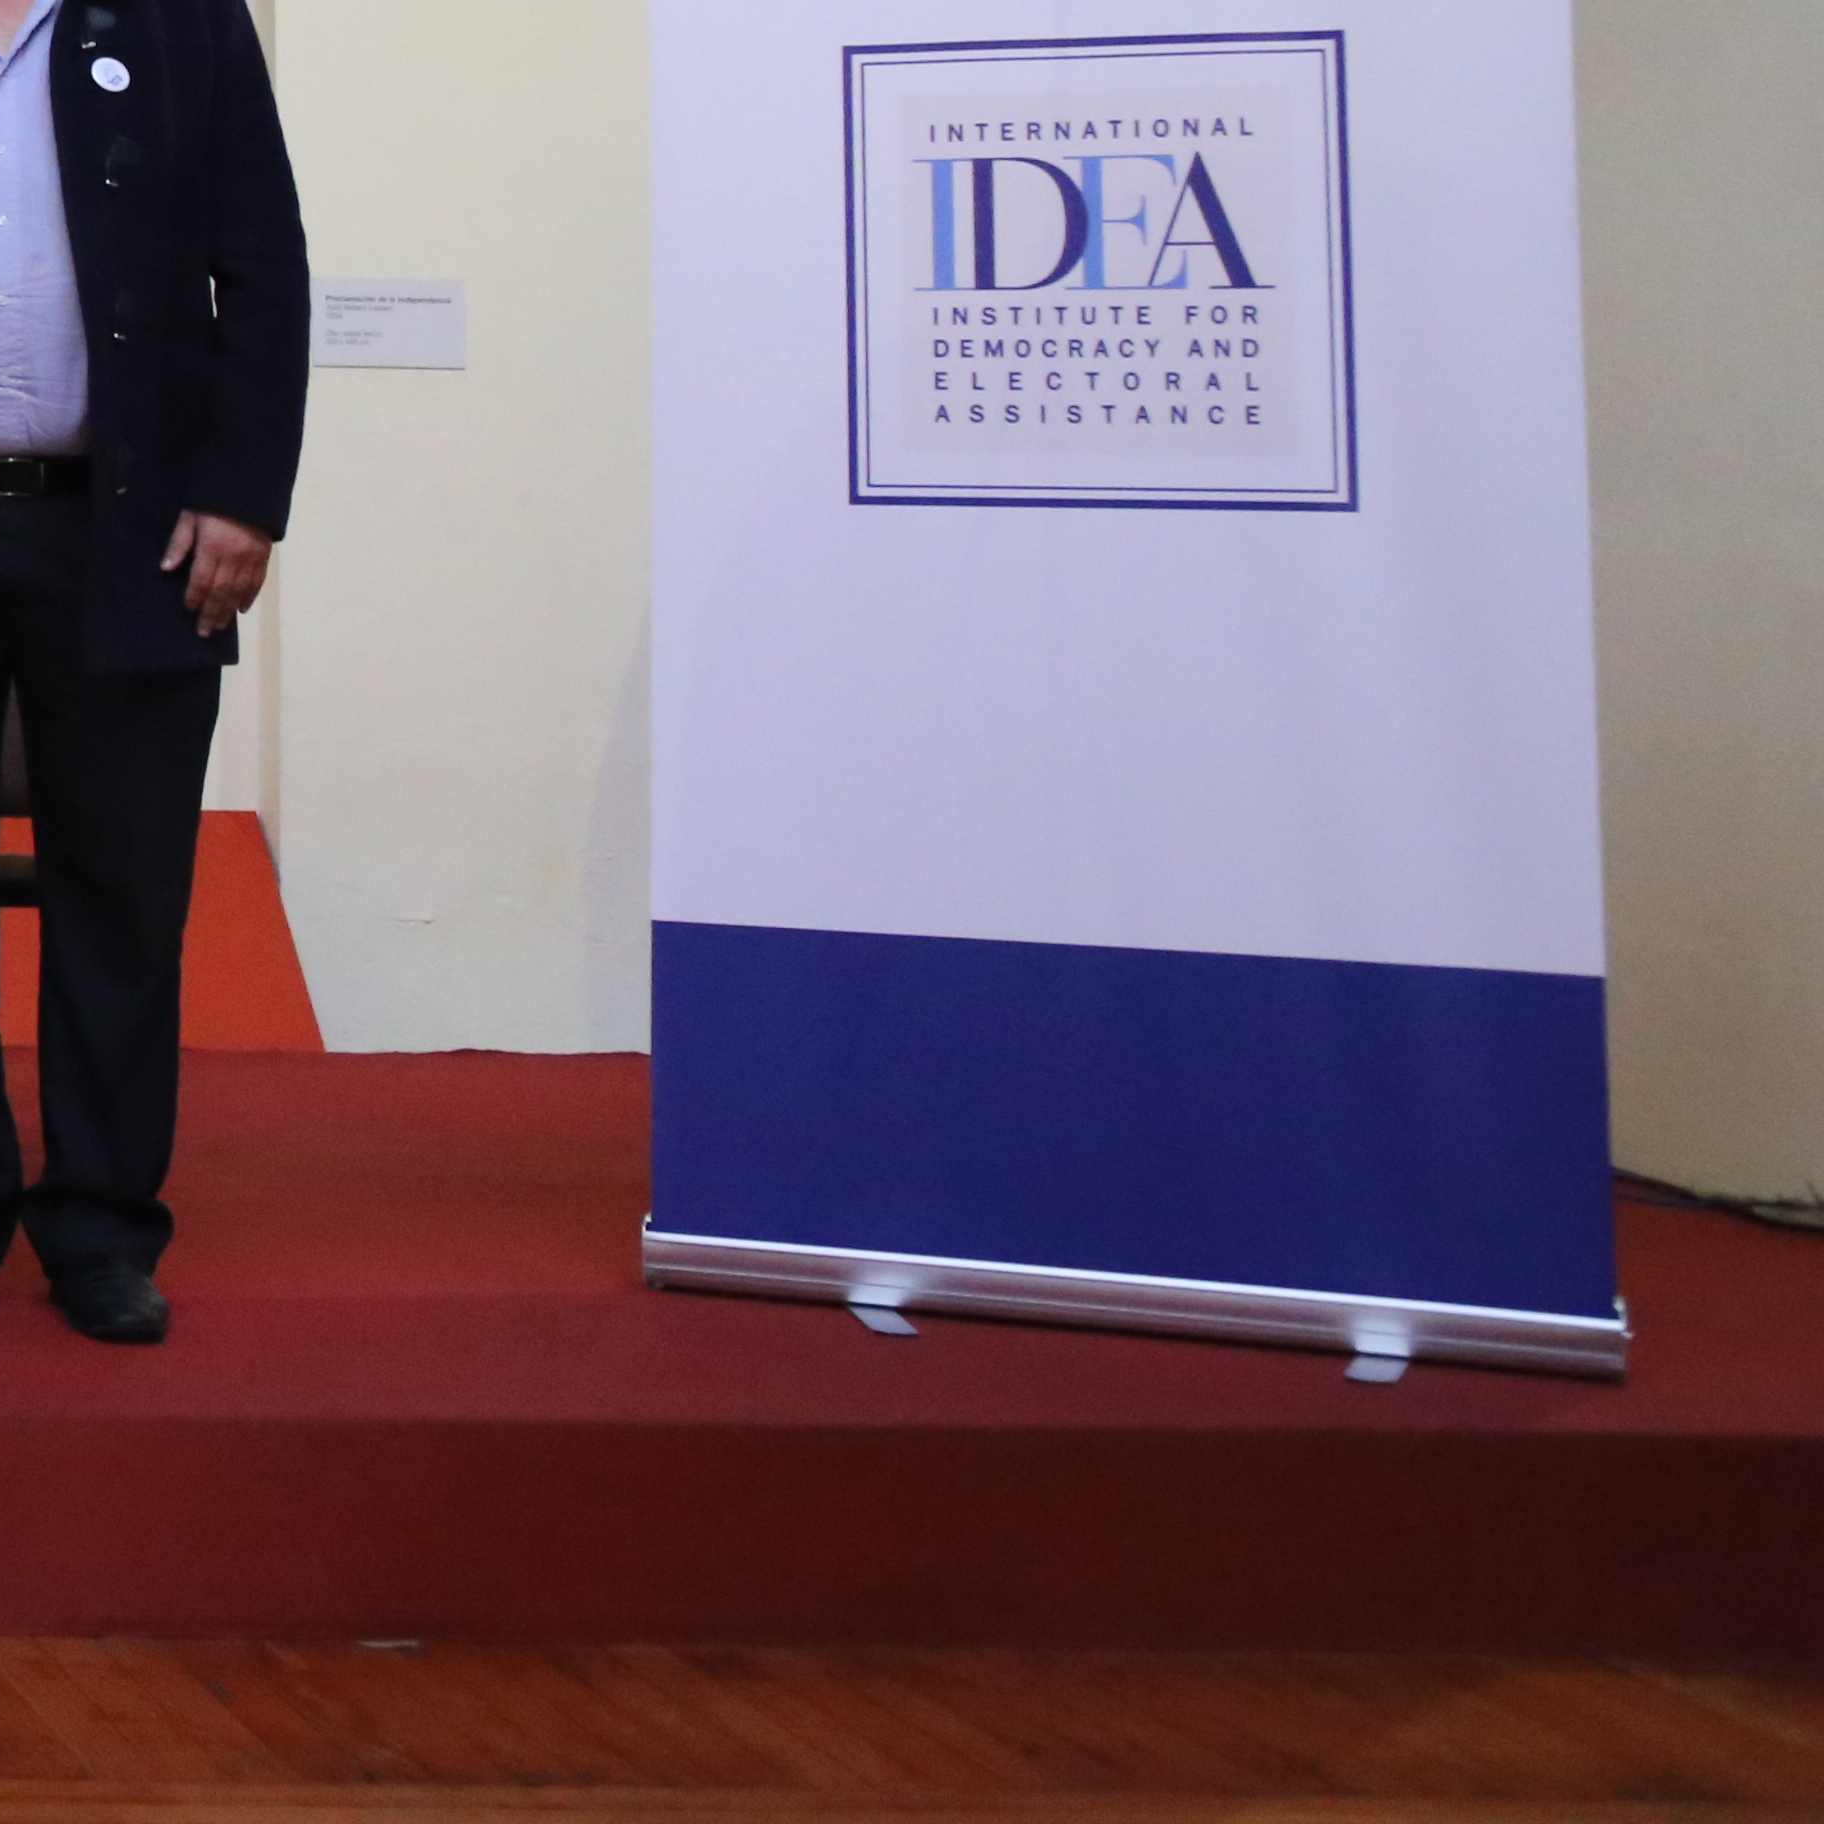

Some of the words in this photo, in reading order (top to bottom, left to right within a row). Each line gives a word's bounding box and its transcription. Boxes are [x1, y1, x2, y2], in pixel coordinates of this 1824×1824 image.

[929, 117, 1255, 143] INTERNATIONAL
[912, 151, 1276, 291] IDEA
[932, 305, 1154, 326] INSTITUTE
[1184, 305, 1260, 325] FOR
[933, 338, 1163, 359] DEMOCRACY
[1186, 338, 1260, 358] AND
[934, 371, 1260, 393] ELECTORAL
[934, 404, 1262, 426] ASSISTANCE
